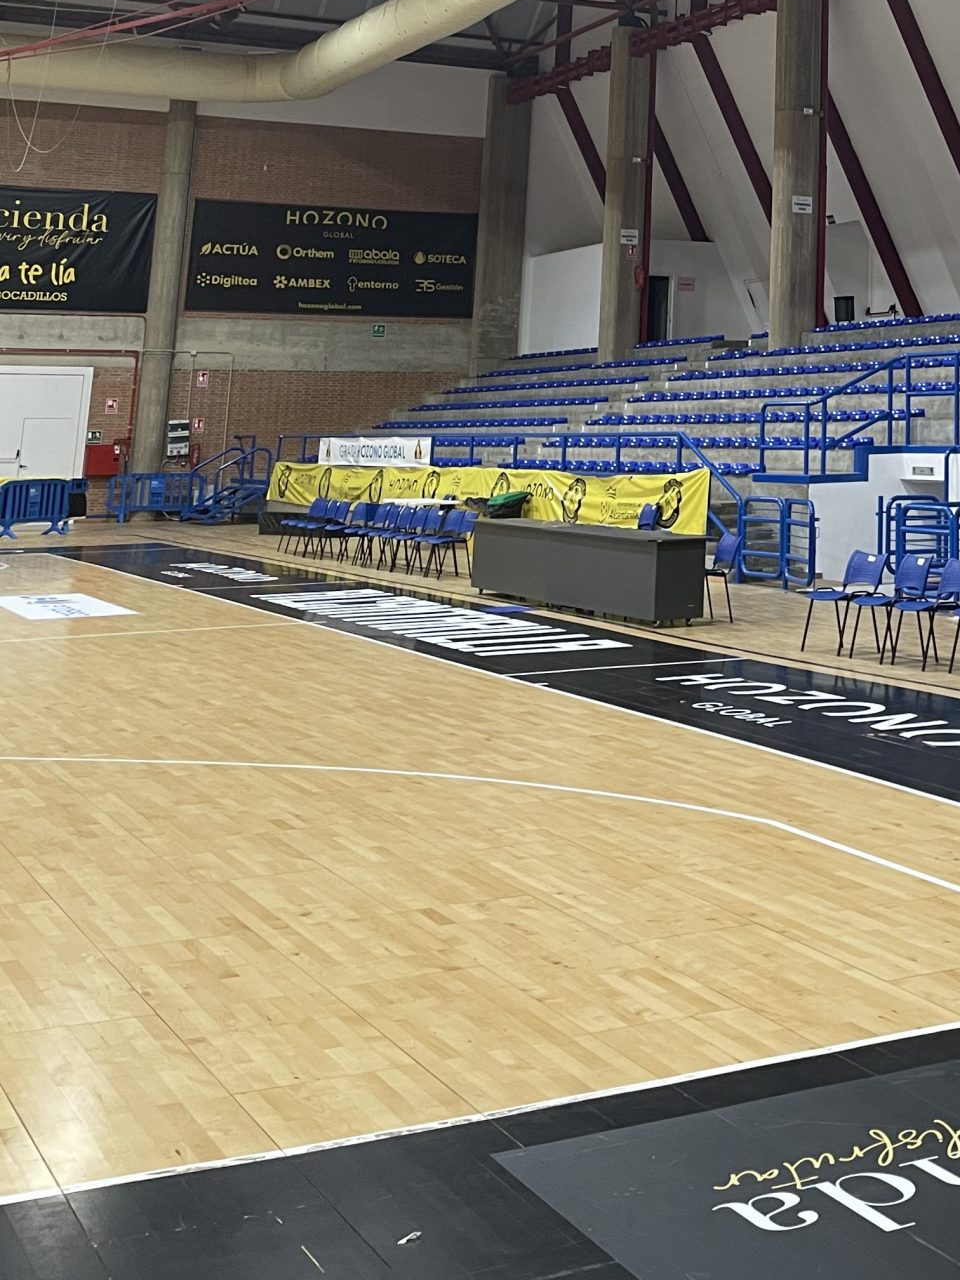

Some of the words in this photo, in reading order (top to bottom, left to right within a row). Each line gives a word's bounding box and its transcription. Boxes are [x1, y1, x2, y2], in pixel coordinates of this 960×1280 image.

[286, 210, 389, 230] HOZONO
[322, 231, 355, 240] GLOBAL
[212, 242, 259, 257] ACTÚA
[293, 246, 335, 260] Orthem
[427, 253, 467, 265] SOTECA
[18, 261, 43, 285] te
[51, 257, 76, 286] lía
[288, 278, 331, 289] AMBEX
[358, 279, 400, 290] entorno
[0, 290, 68, 302] OCADILLOS
[691, 701, 793, 729] GLOBAL
